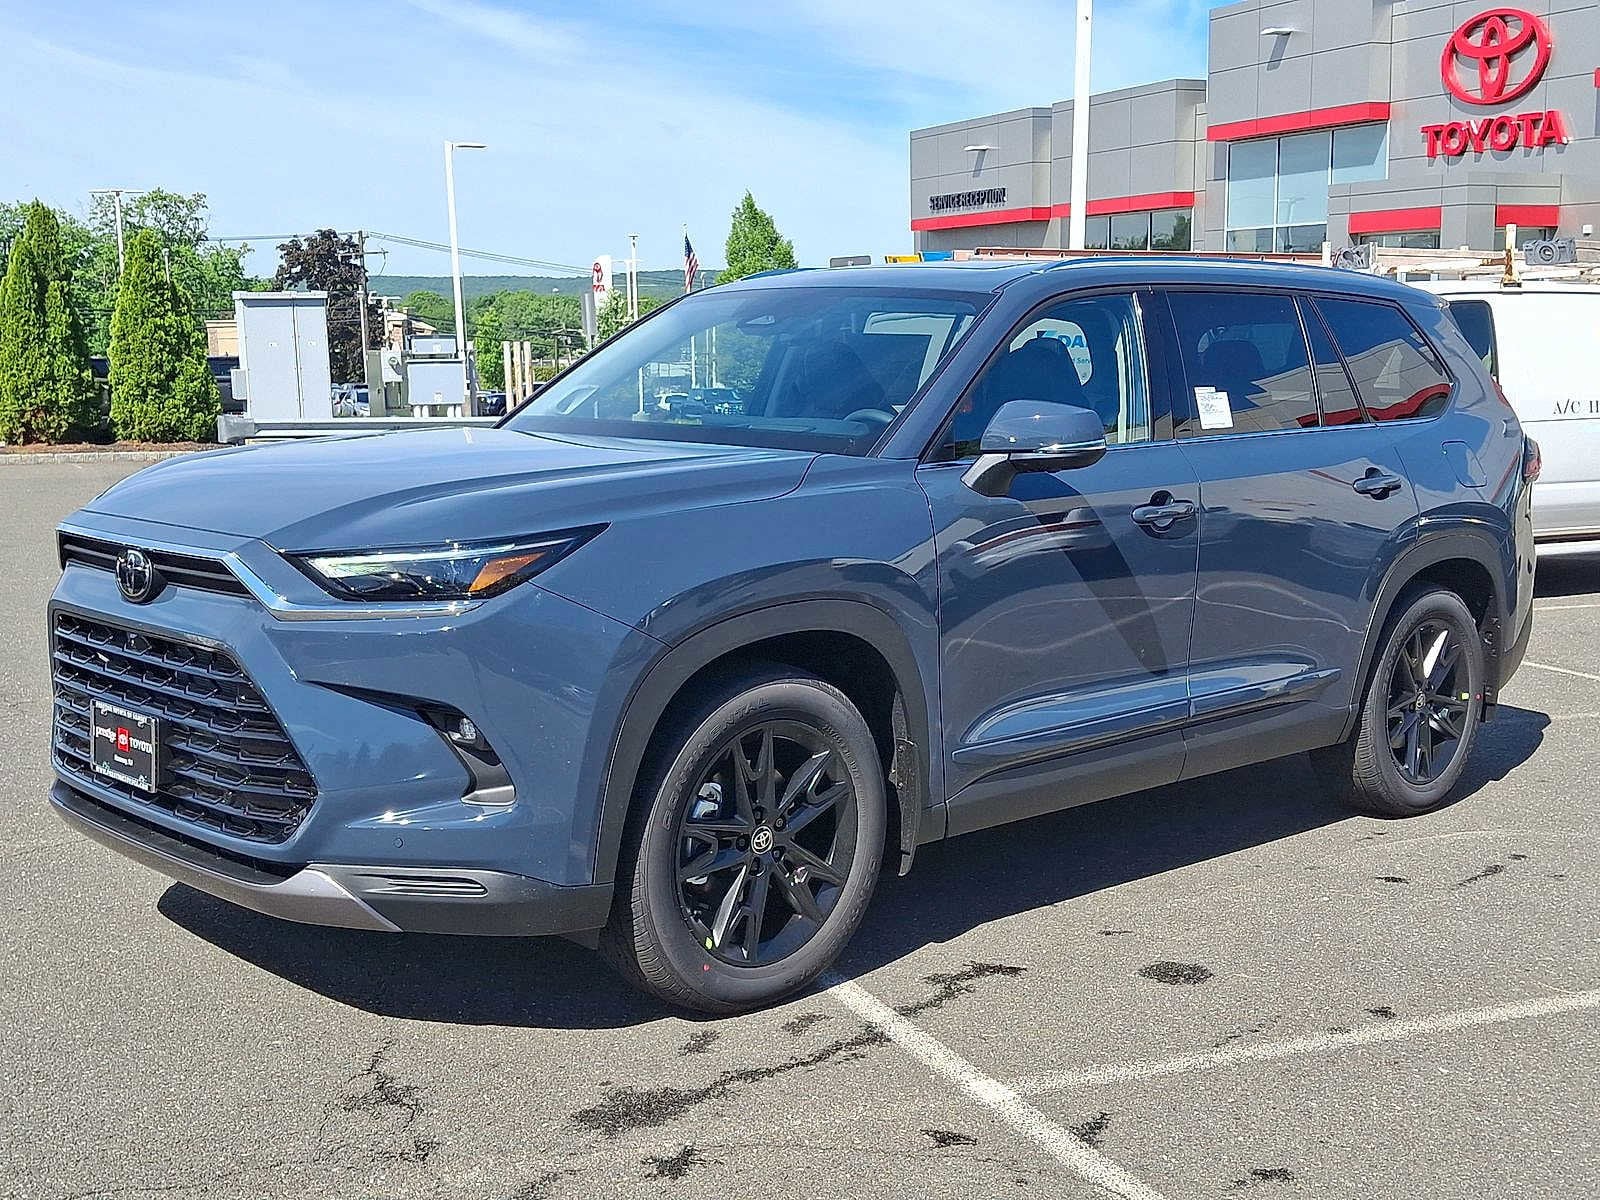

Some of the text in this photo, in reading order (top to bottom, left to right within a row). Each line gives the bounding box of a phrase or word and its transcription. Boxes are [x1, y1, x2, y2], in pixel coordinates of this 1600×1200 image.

[1421, 110, 1566, 158] TOYOTA
[929, 187, 1006, 211] SERVICE RECEPTION
[1553, 398, 1581, 414] A/C
[129, 737, 153, 754] TOYOTA
